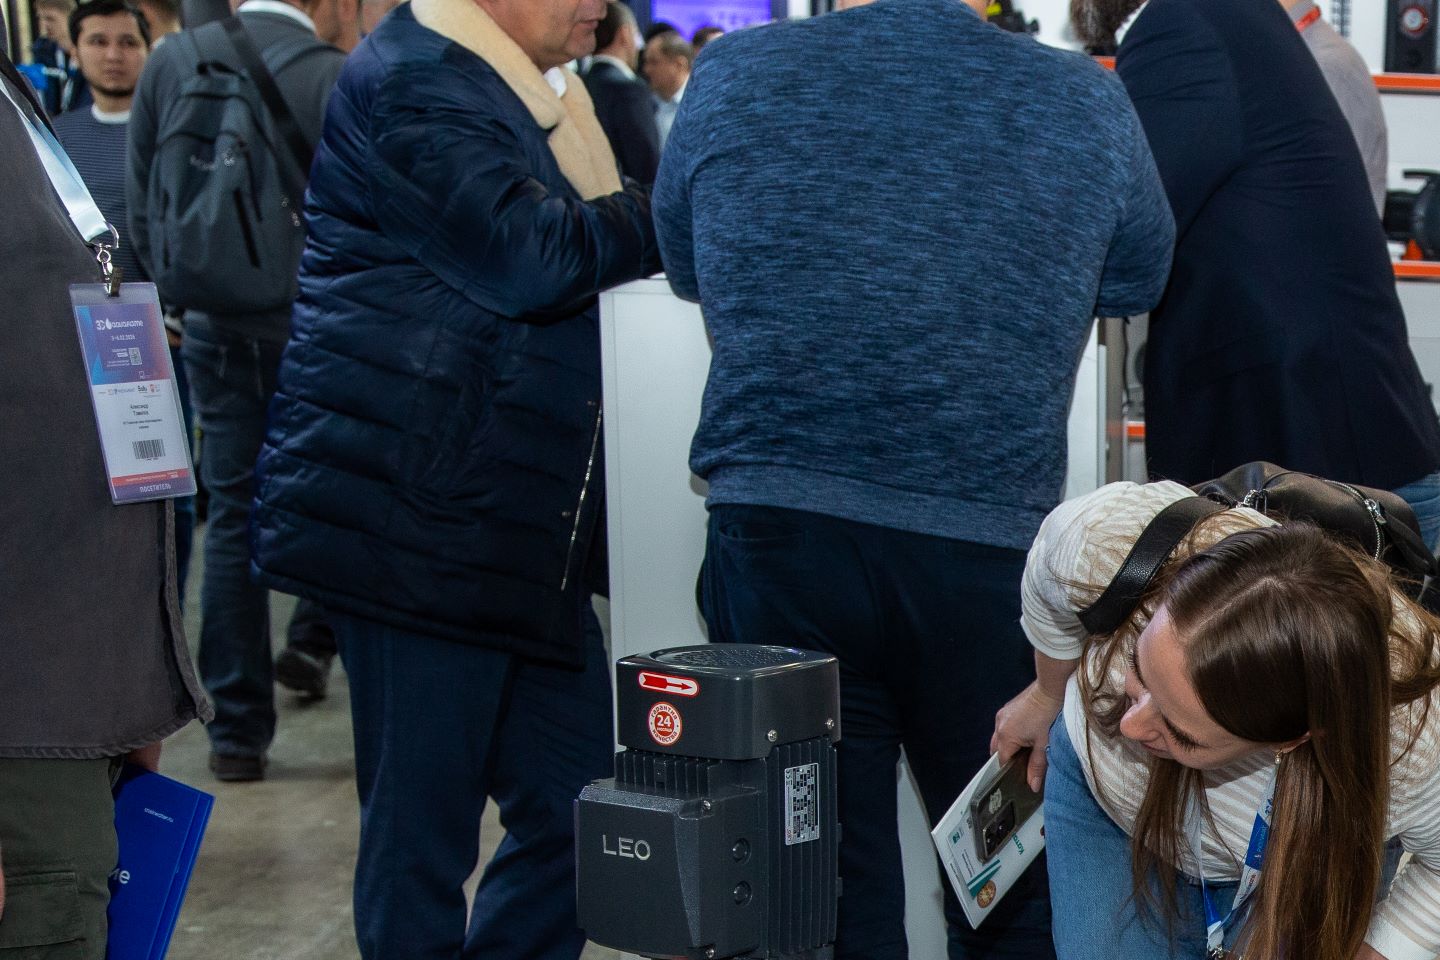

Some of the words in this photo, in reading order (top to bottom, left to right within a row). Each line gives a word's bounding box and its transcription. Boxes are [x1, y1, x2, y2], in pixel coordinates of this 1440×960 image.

[651, 705, 678, 721] гарантия
[656, 714, 672, 728] 24
[652, 728, 678, 743] качества
[602, 834, 651, 861] LEO
